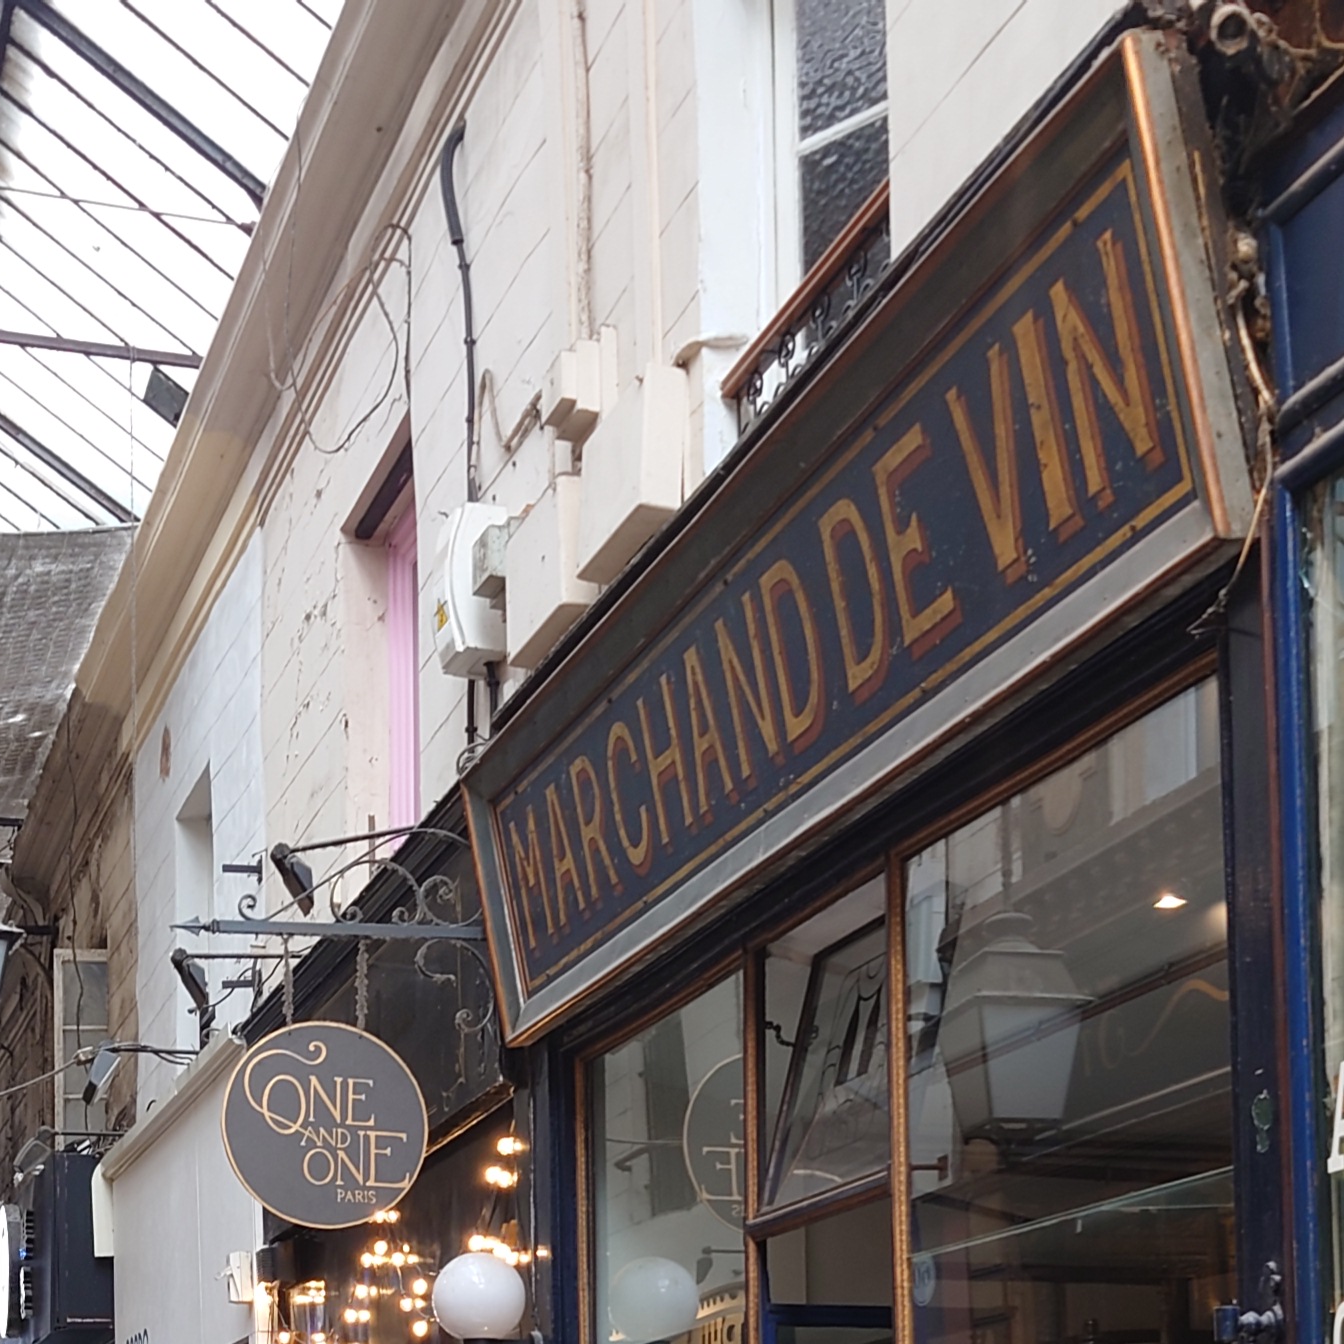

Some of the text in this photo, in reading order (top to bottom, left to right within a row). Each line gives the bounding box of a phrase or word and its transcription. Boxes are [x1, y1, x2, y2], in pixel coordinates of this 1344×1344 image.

[508, 226, 1167, 957] MARCHAND DE VIN
[260, 1072, 375, 1136] ONE
[300, 1126, 352, 1149] AND
[302, 1130, 412, 1188] ONE
[336, 1189, 377, 1205] PARIS
